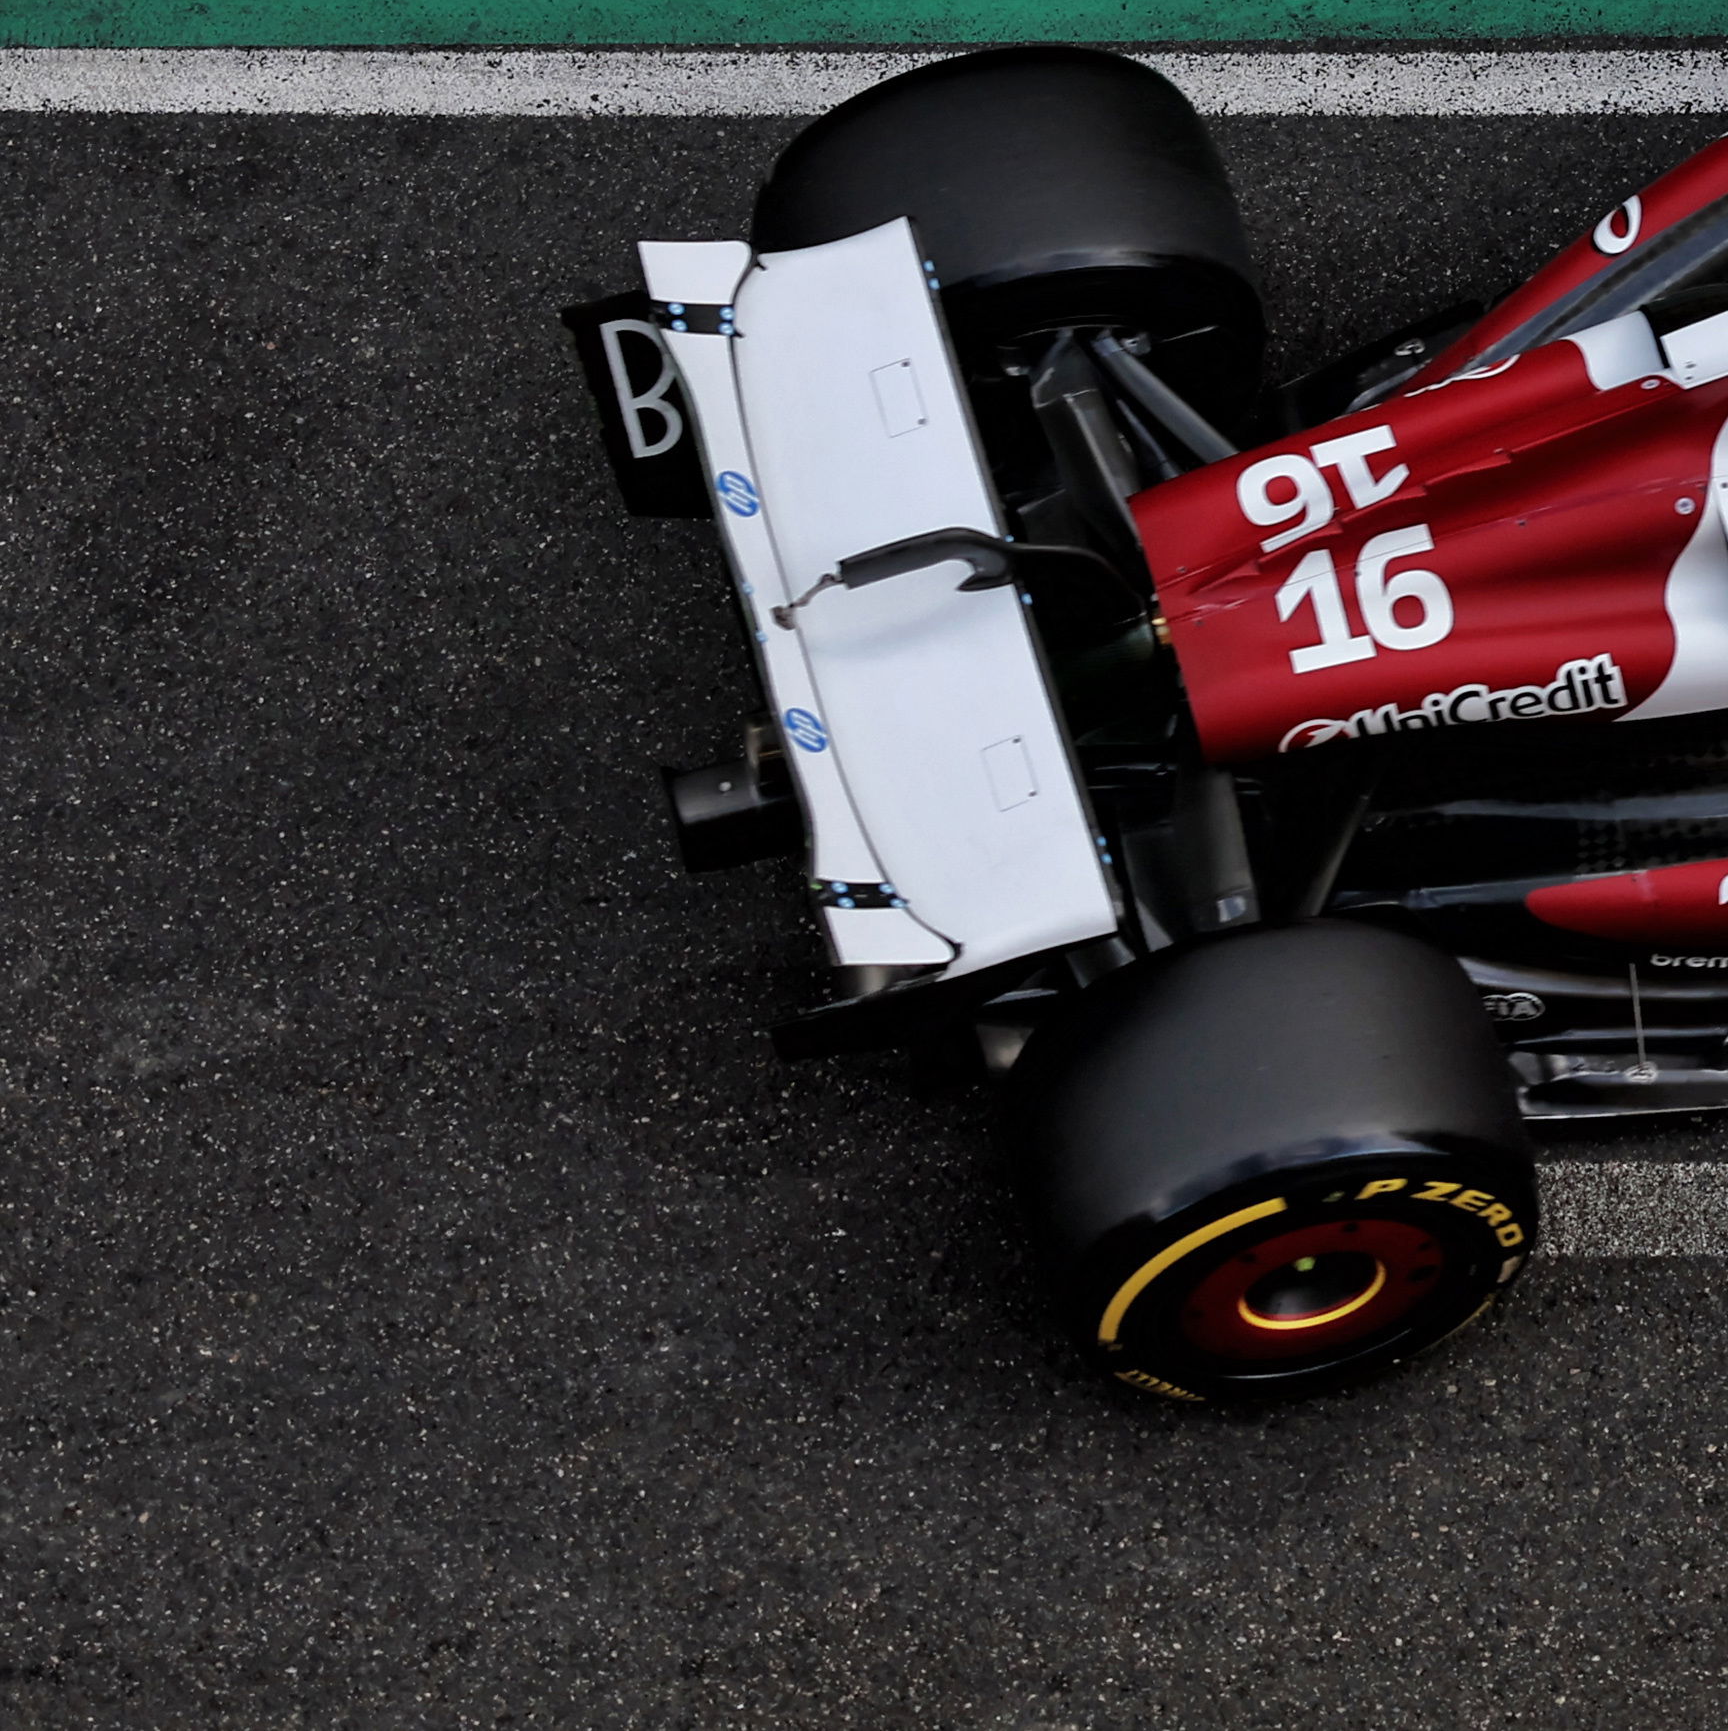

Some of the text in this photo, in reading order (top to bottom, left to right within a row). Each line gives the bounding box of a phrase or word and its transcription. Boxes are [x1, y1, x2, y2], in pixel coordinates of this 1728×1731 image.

[1235, 425, 1410, 552] 16
[1273, 523, 1455, 675] 16
[1347, 653, 1628, 738] UniCredit
[1353, 1178, 1525, 1248] P ZERO
